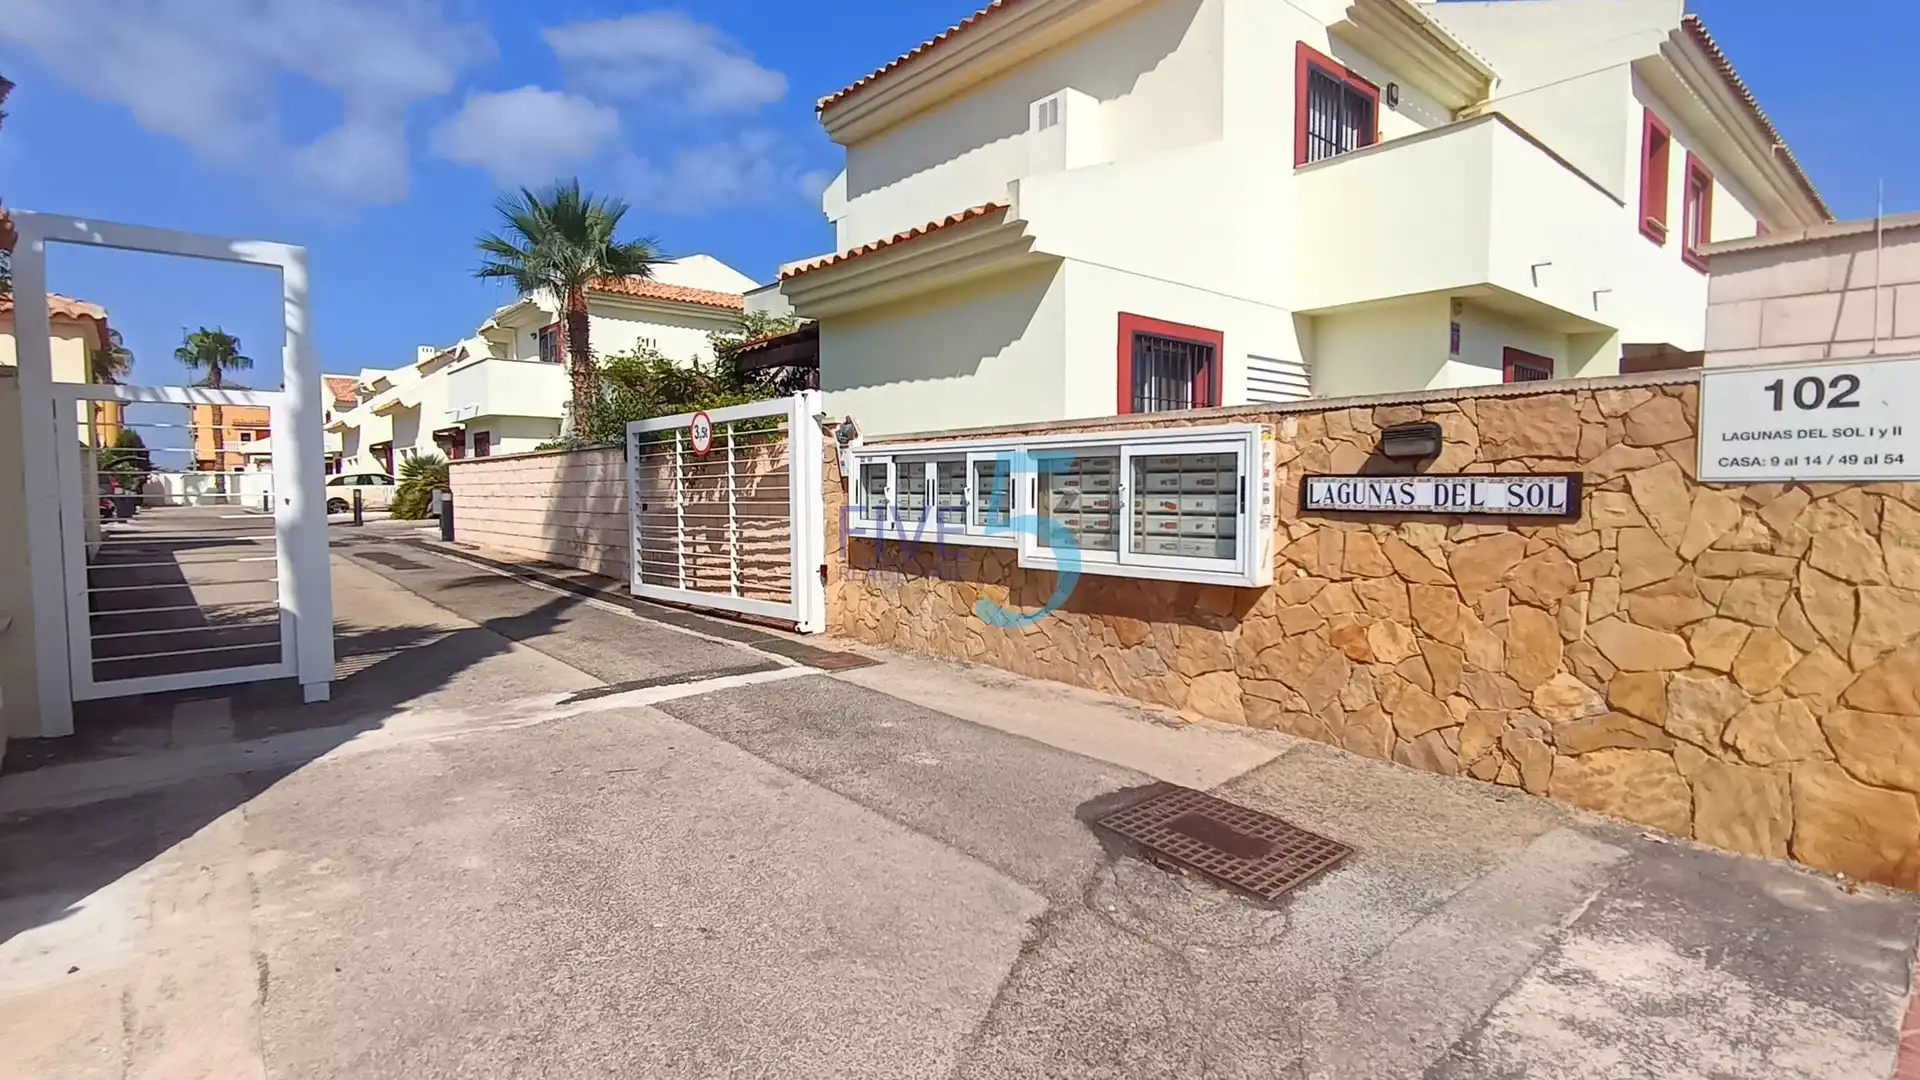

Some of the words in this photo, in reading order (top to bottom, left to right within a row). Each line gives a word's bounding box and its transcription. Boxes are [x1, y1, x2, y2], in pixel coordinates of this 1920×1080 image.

[1764, 374, 1860, 411] 102
[1722, 429, 1792, 441] LAGUNAS
[1797, 428, 1827, 439] DEL
[1832, 427, 1865, 438] SOL
[1869, 427, 1874, 436] I
[1878, 429, 1888, 439] y
[1892, 426, 1902, 436] II
[1718, 456, 1766, 468] CASA:
[1770, 456, 1780, 466] 9
[1784, 455, 1798, 466] al
[1804, 455, 1821, 466] 14
[1826, 455, 1834, 465] /
[1838, 454, 1858, 465] 49
[1863, 454, 1878, 464] al
[1883, 453, 1904, 464] 54
[1309, 482, 1415, 505] LAGUNAS
[1434, 483, 1485, 506] DEL
[1507, 483, 1564, 509] SOL
